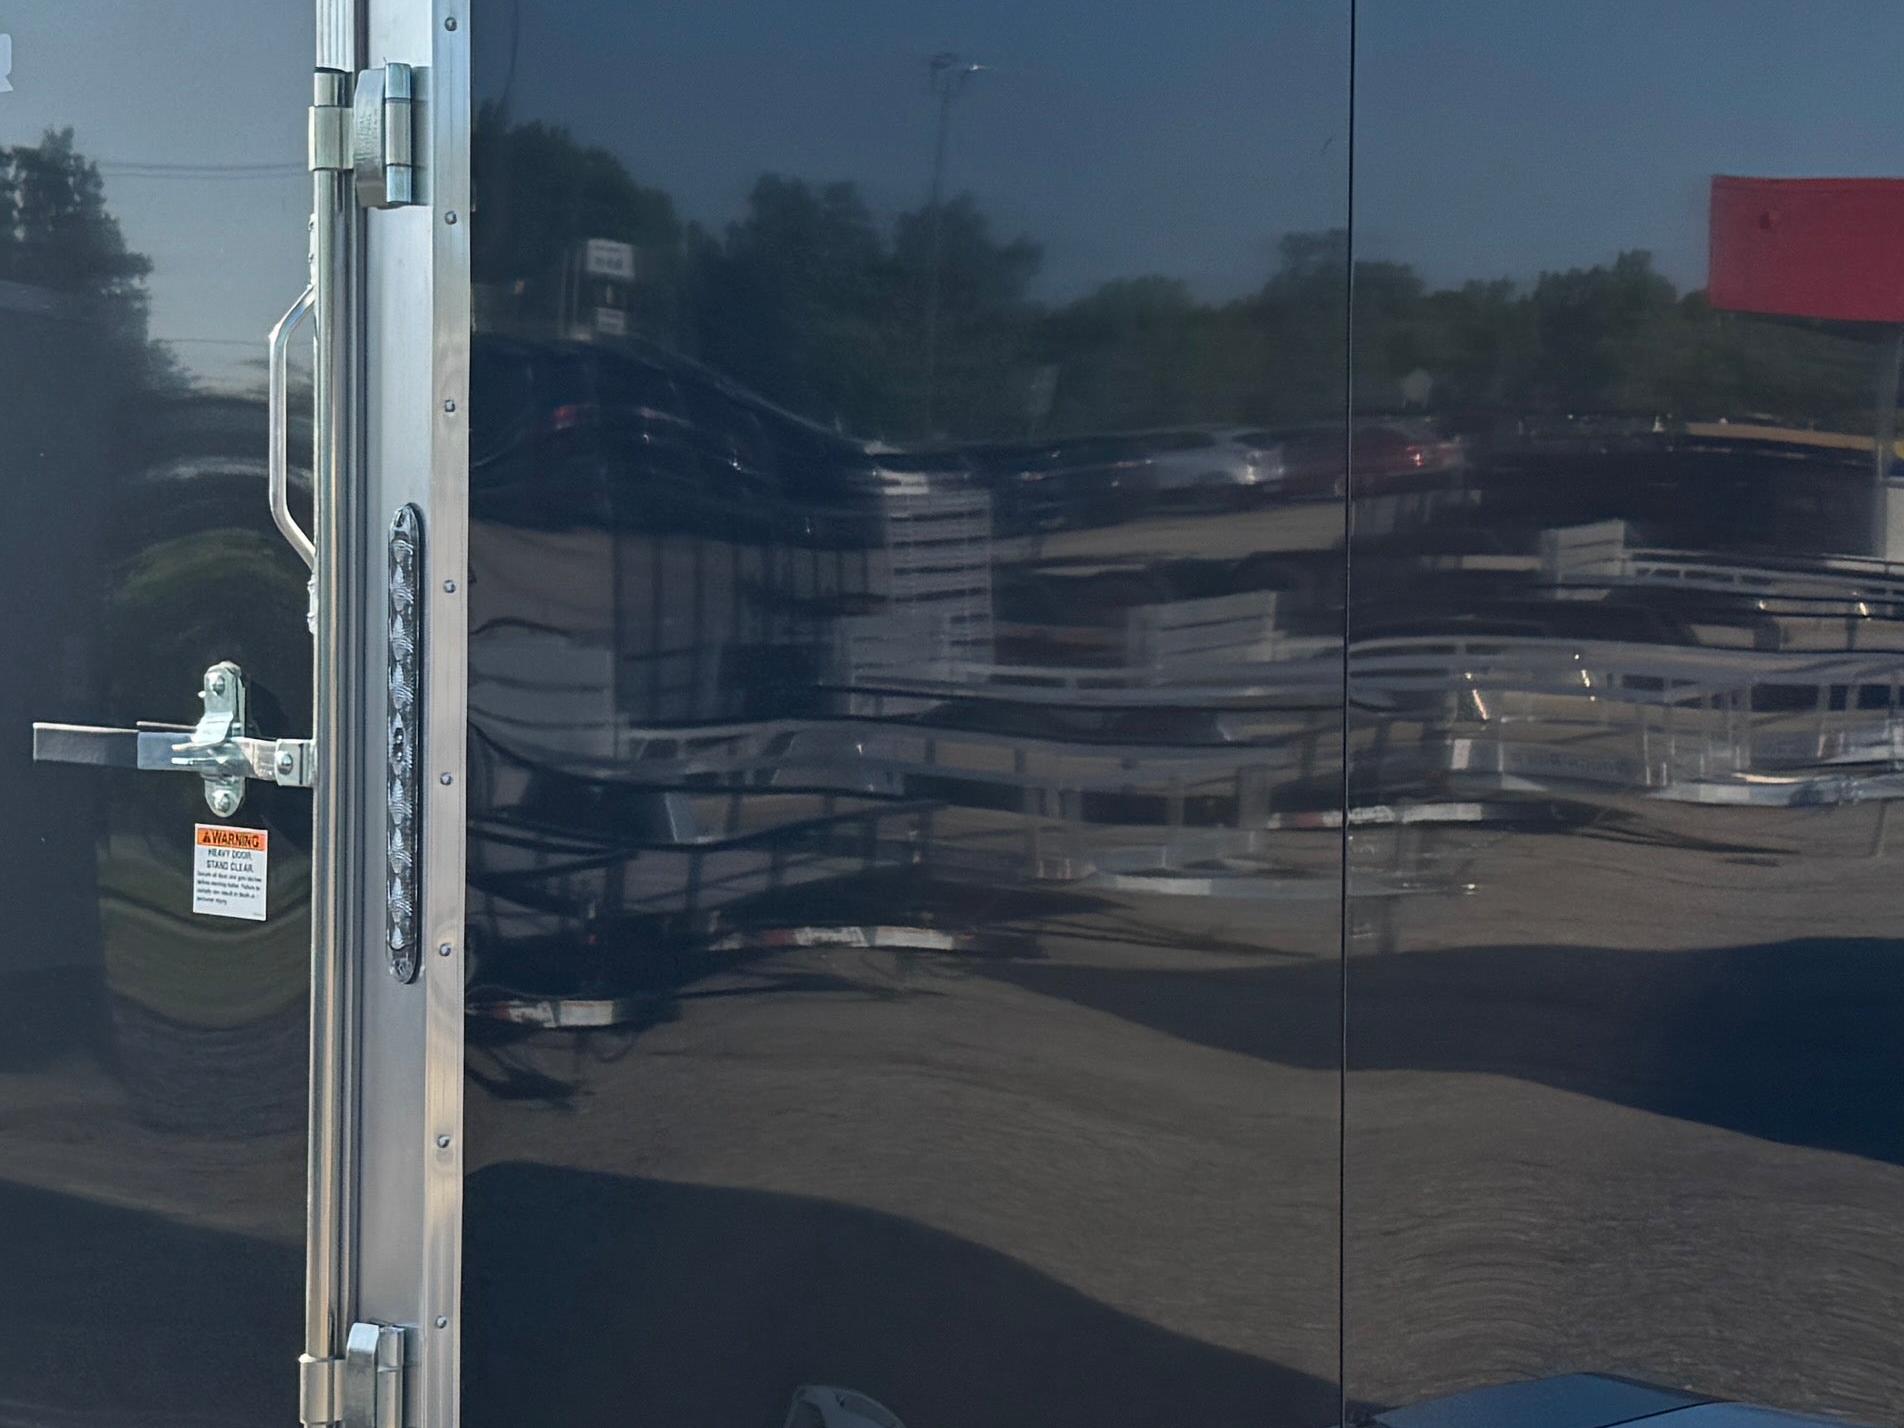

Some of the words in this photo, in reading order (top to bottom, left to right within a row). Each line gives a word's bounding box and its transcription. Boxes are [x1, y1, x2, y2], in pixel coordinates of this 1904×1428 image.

[212, 831, 260, 848] WARNING
[208, 848, 230, 857] HEAVY
[206, 859, 229, 870] STAND
